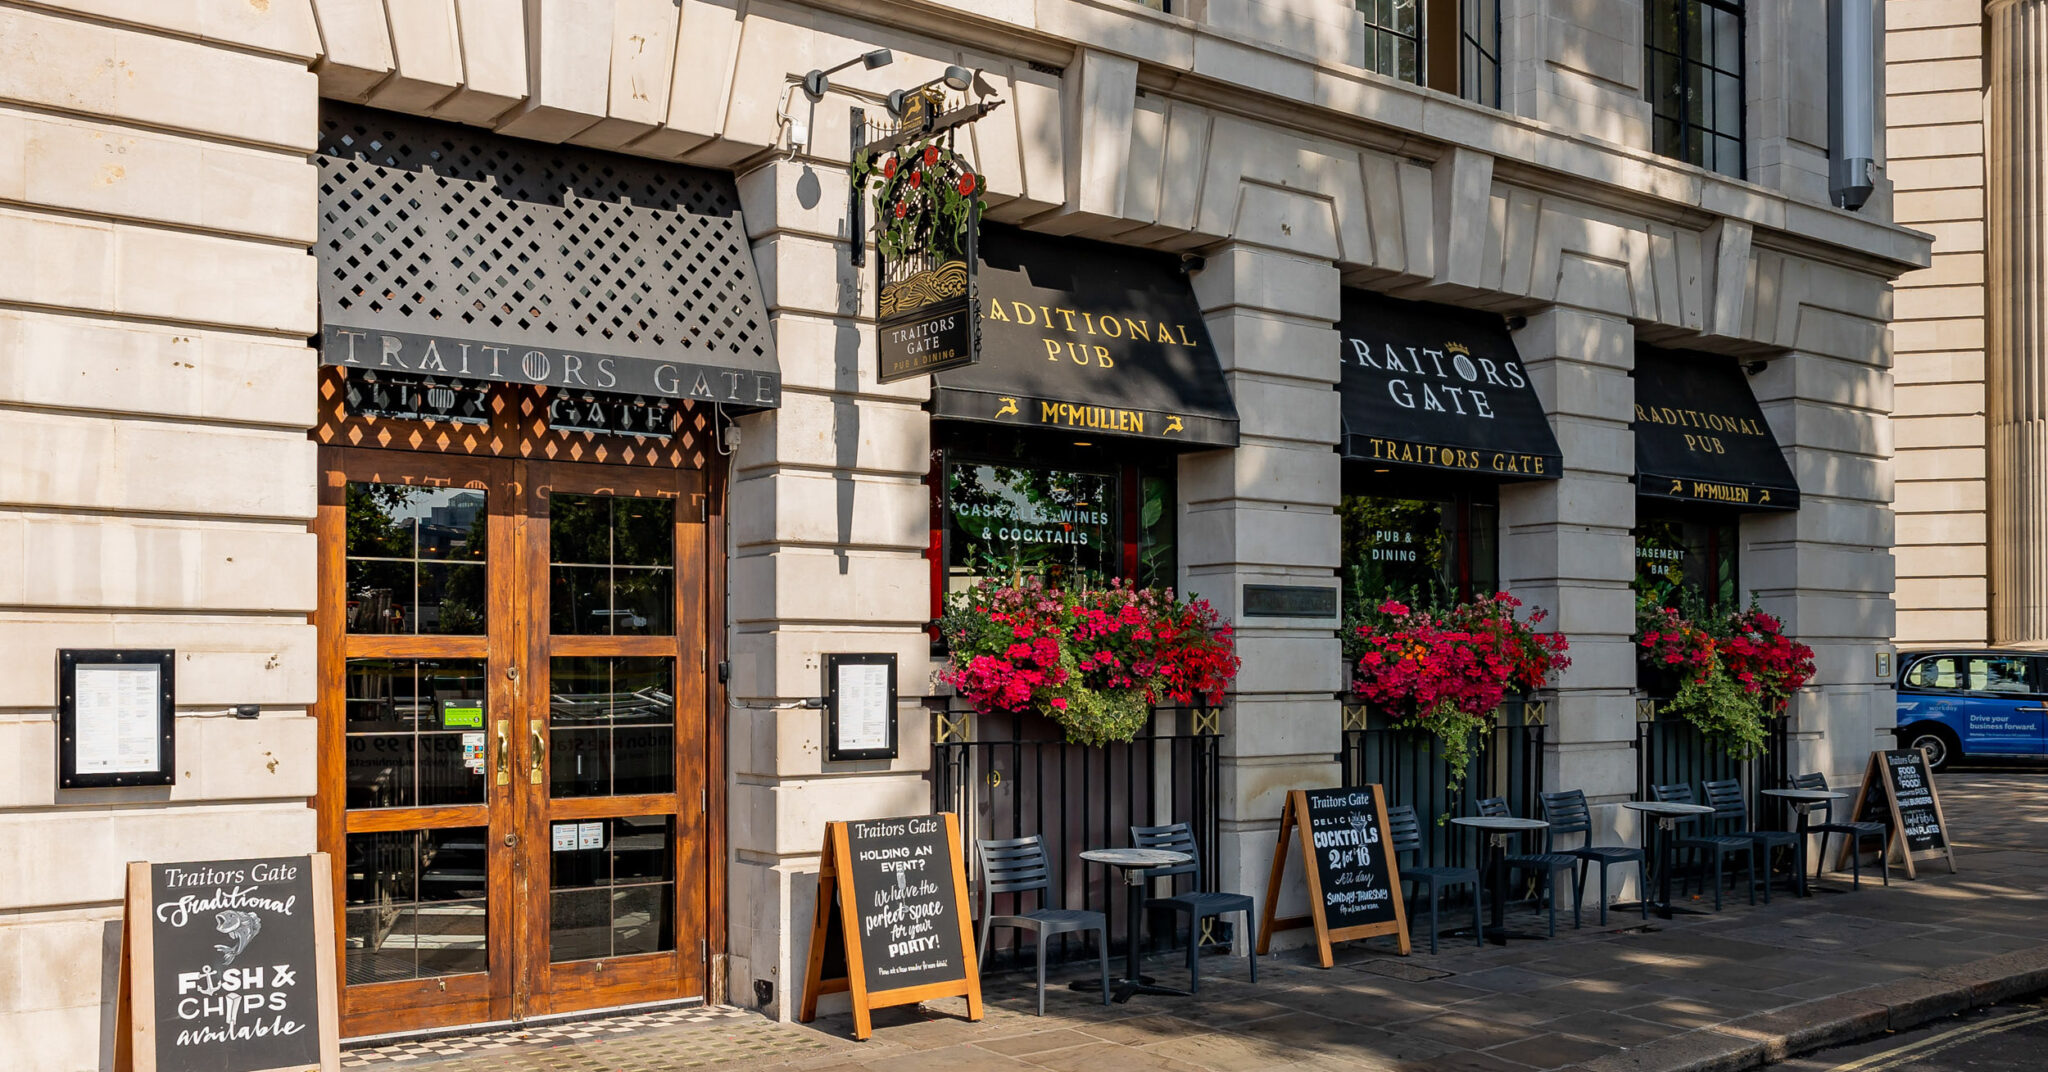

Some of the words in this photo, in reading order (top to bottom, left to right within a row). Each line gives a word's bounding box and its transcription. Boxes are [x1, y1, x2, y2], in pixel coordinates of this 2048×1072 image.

[892, 316, 955, 344] TRAITORS
[979, 297, 1197, 347] ADITIONAL
[907, 336, 939, 355] GATE
[1043, 338, 1115, 368] PUB
[336, 329, 617, 389] TRAITORS
[653, 364, 774, 403] GATE
[894, 361, 909, 371] PUB
[923, 349, 955, 364] DINING
[1340, 338, 1526, 389] RAITORS
[1388, 379, 1495, 419] GATE
[1634, 403, 1764, 436] RADITIONAL
[1684, 434, 1725, 455] PUB
[1370, 438, 1479, 469] TRAITORS
[1493, 453, 1544, 474] GATE
[959, 503, 1001, 518] CASK
[1060, 509, 1108, 525] WINES
[982, 527, 992, 540] &
[999, 527, 1088, 545] COCKTAILS
[1376, 530, 1399, 542] PUB
[1405, 532, 1412, 543] &
[1372, 549, 1416, 561] DINING
[1636, 547, 1685, 560] BASEMENT
[1651, 564, 1669, 575] BAR
[1898, 766, 1916, 775] FOOD
[1311, 795, 1347, 808] Traitors
[1348, 793, 1369, 806] Gate
[855, 822, 905, 839] Traitors
[908, 819, 938, 835] Gate
[860, 847, 910, 861] HOLDING
[914, 845, 932, 856] AN
[1329, 849, 1341, 869] 2
[165, 867, 244, 888] Traitors
[251, 863, 297, 883] Gate
[881, 859, 926, 873] EVENT?
[1355, 870, 1374, 887] day
[874, 889, 890, 907] We
[920, 879, 938, 896] the
[156, 886, 296, 927] Traditional
[866, 903, 905, 936] perfect
[909, 900, 944, 924] space
[890, 923, 907, 942] for
[908, 919, 933, 939] your
[888, 934, 941, 958] PARTY!
[271, 964, 297, 987] &
[176, 1015, 306, 1046] available
